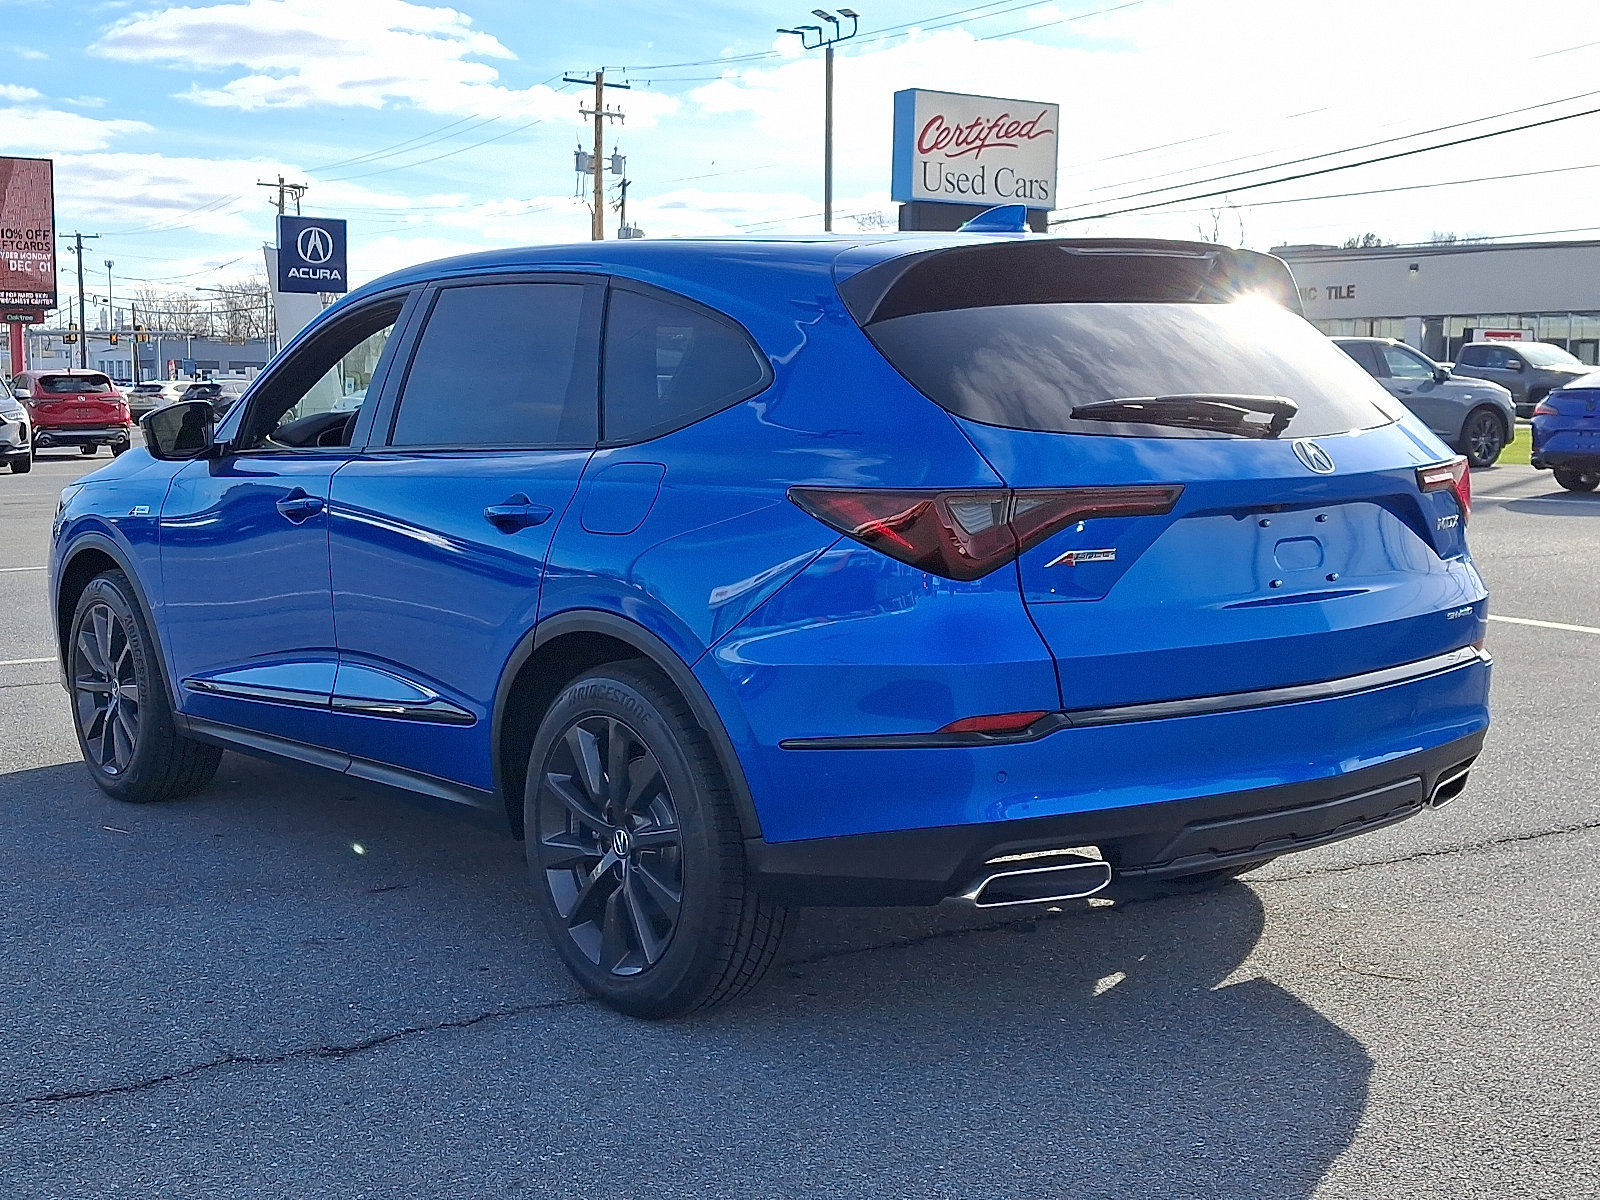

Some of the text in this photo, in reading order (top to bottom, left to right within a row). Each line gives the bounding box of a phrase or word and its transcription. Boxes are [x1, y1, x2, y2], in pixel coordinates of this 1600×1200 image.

[917, 110, 1054, 160] Certified
[921, 161, 1049, 200] Used Cars
[0, 228, 51, 241] 10% OFF
[0, 240, 51, 252] FTCARDS
[20, 252, 52, 261] MONDAY
[9, 259, 51, 273] DEC 01
[287, 267, 342, 281] ACURA
[1325, 284, 1356, 301] TILE
[566, 684, 655, 726] BRIDGESTONE
